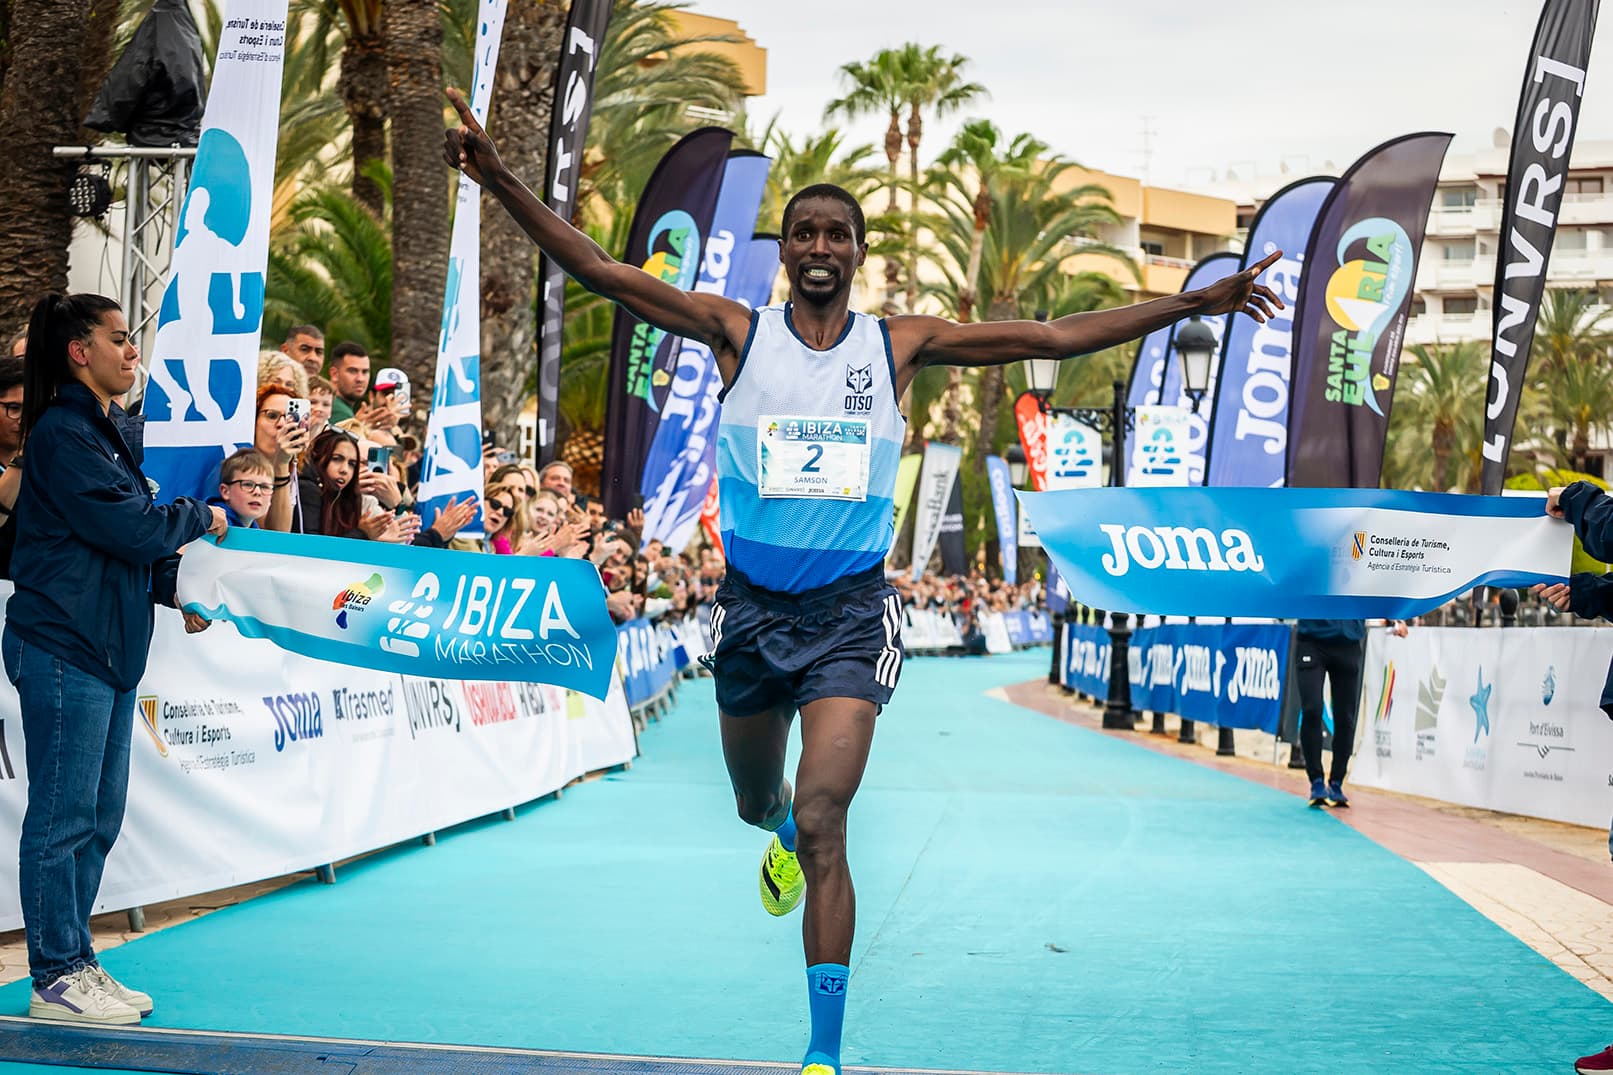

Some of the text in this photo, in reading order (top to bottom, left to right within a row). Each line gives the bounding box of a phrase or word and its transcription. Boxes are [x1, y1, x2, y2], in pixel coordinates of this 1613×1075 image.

[1325, 329, 1348, 402] SANTA
[844, 395, 873, 411] OTSO
[802, 421, 842, 434] IBIZA
[801, 444, 824, 473] 2
[1370, 535, 1450, 551] Conselleria de Turisme,
[1369, 547, 1394, 558] Cultura
[1400, 550, 1424, 561] Esports
[341, 589, 372, 605] Ibiza
[442, 574, 581, 640] IBIZA
[434, 633, 593, 671] MARATHON
[163, 725, 231, 747] Cultura i Esports
